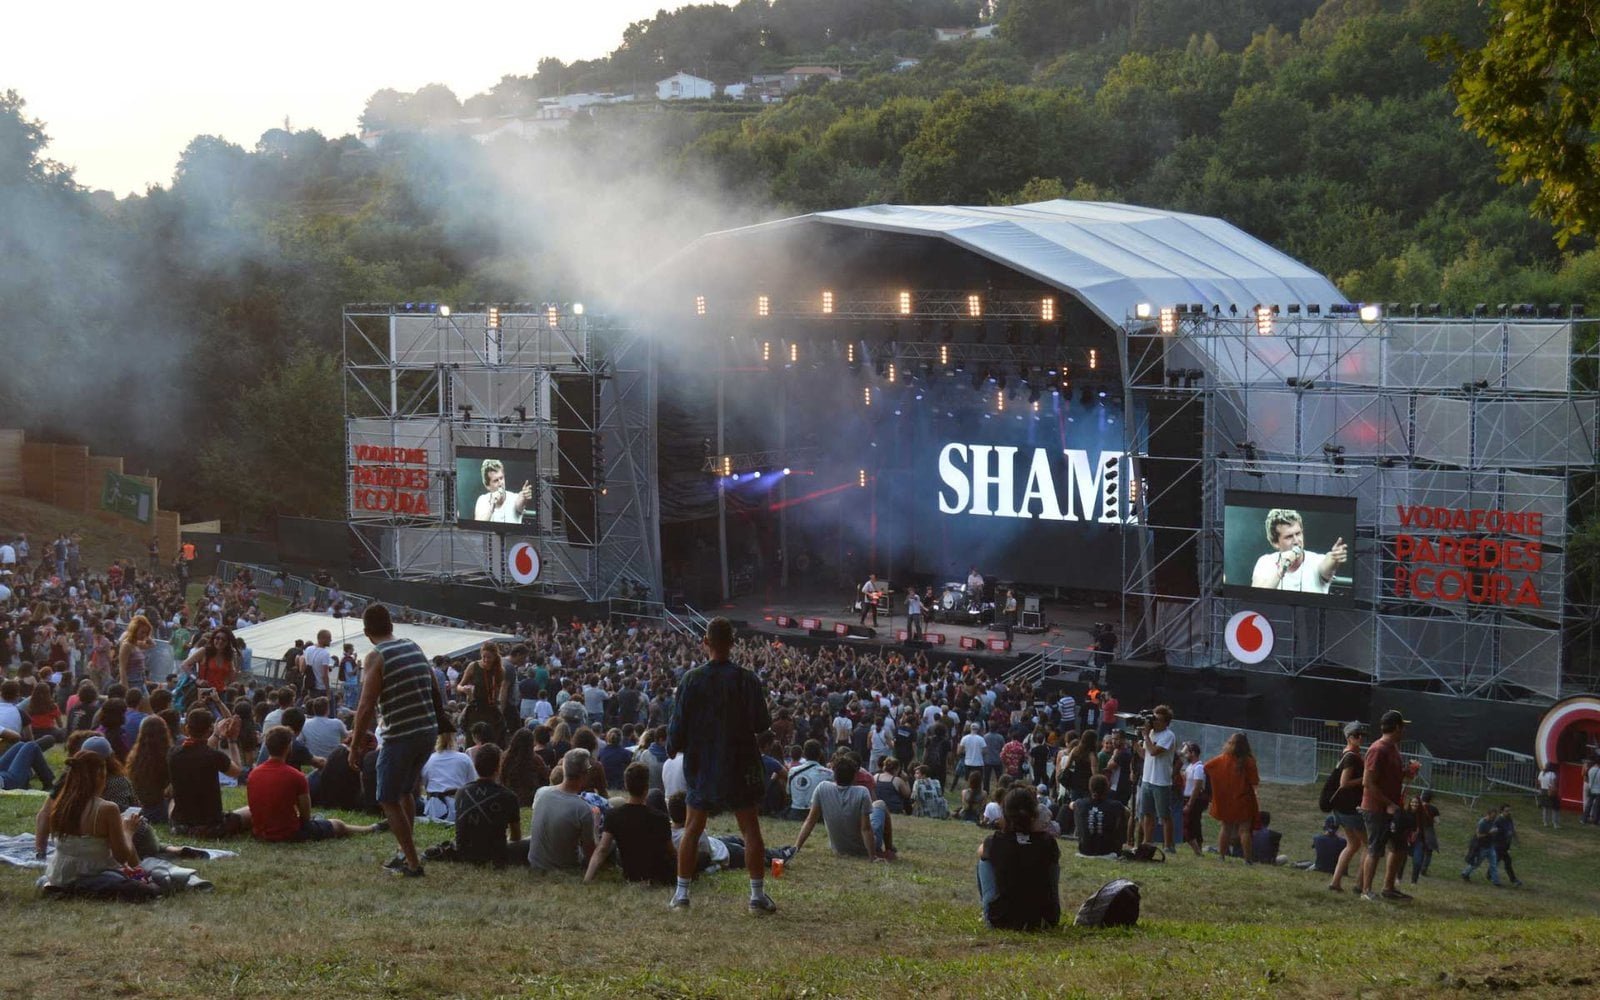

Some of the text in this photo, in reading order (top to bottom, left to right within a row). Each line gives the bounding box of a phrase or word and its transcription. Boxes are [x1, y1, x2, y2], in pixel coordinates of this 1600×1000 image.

[1397, 505, 1543, 536] VODAFONE
[1396, 534, 1543, 572] PAREDES
[1409, 568, 1543, 608] COURA
